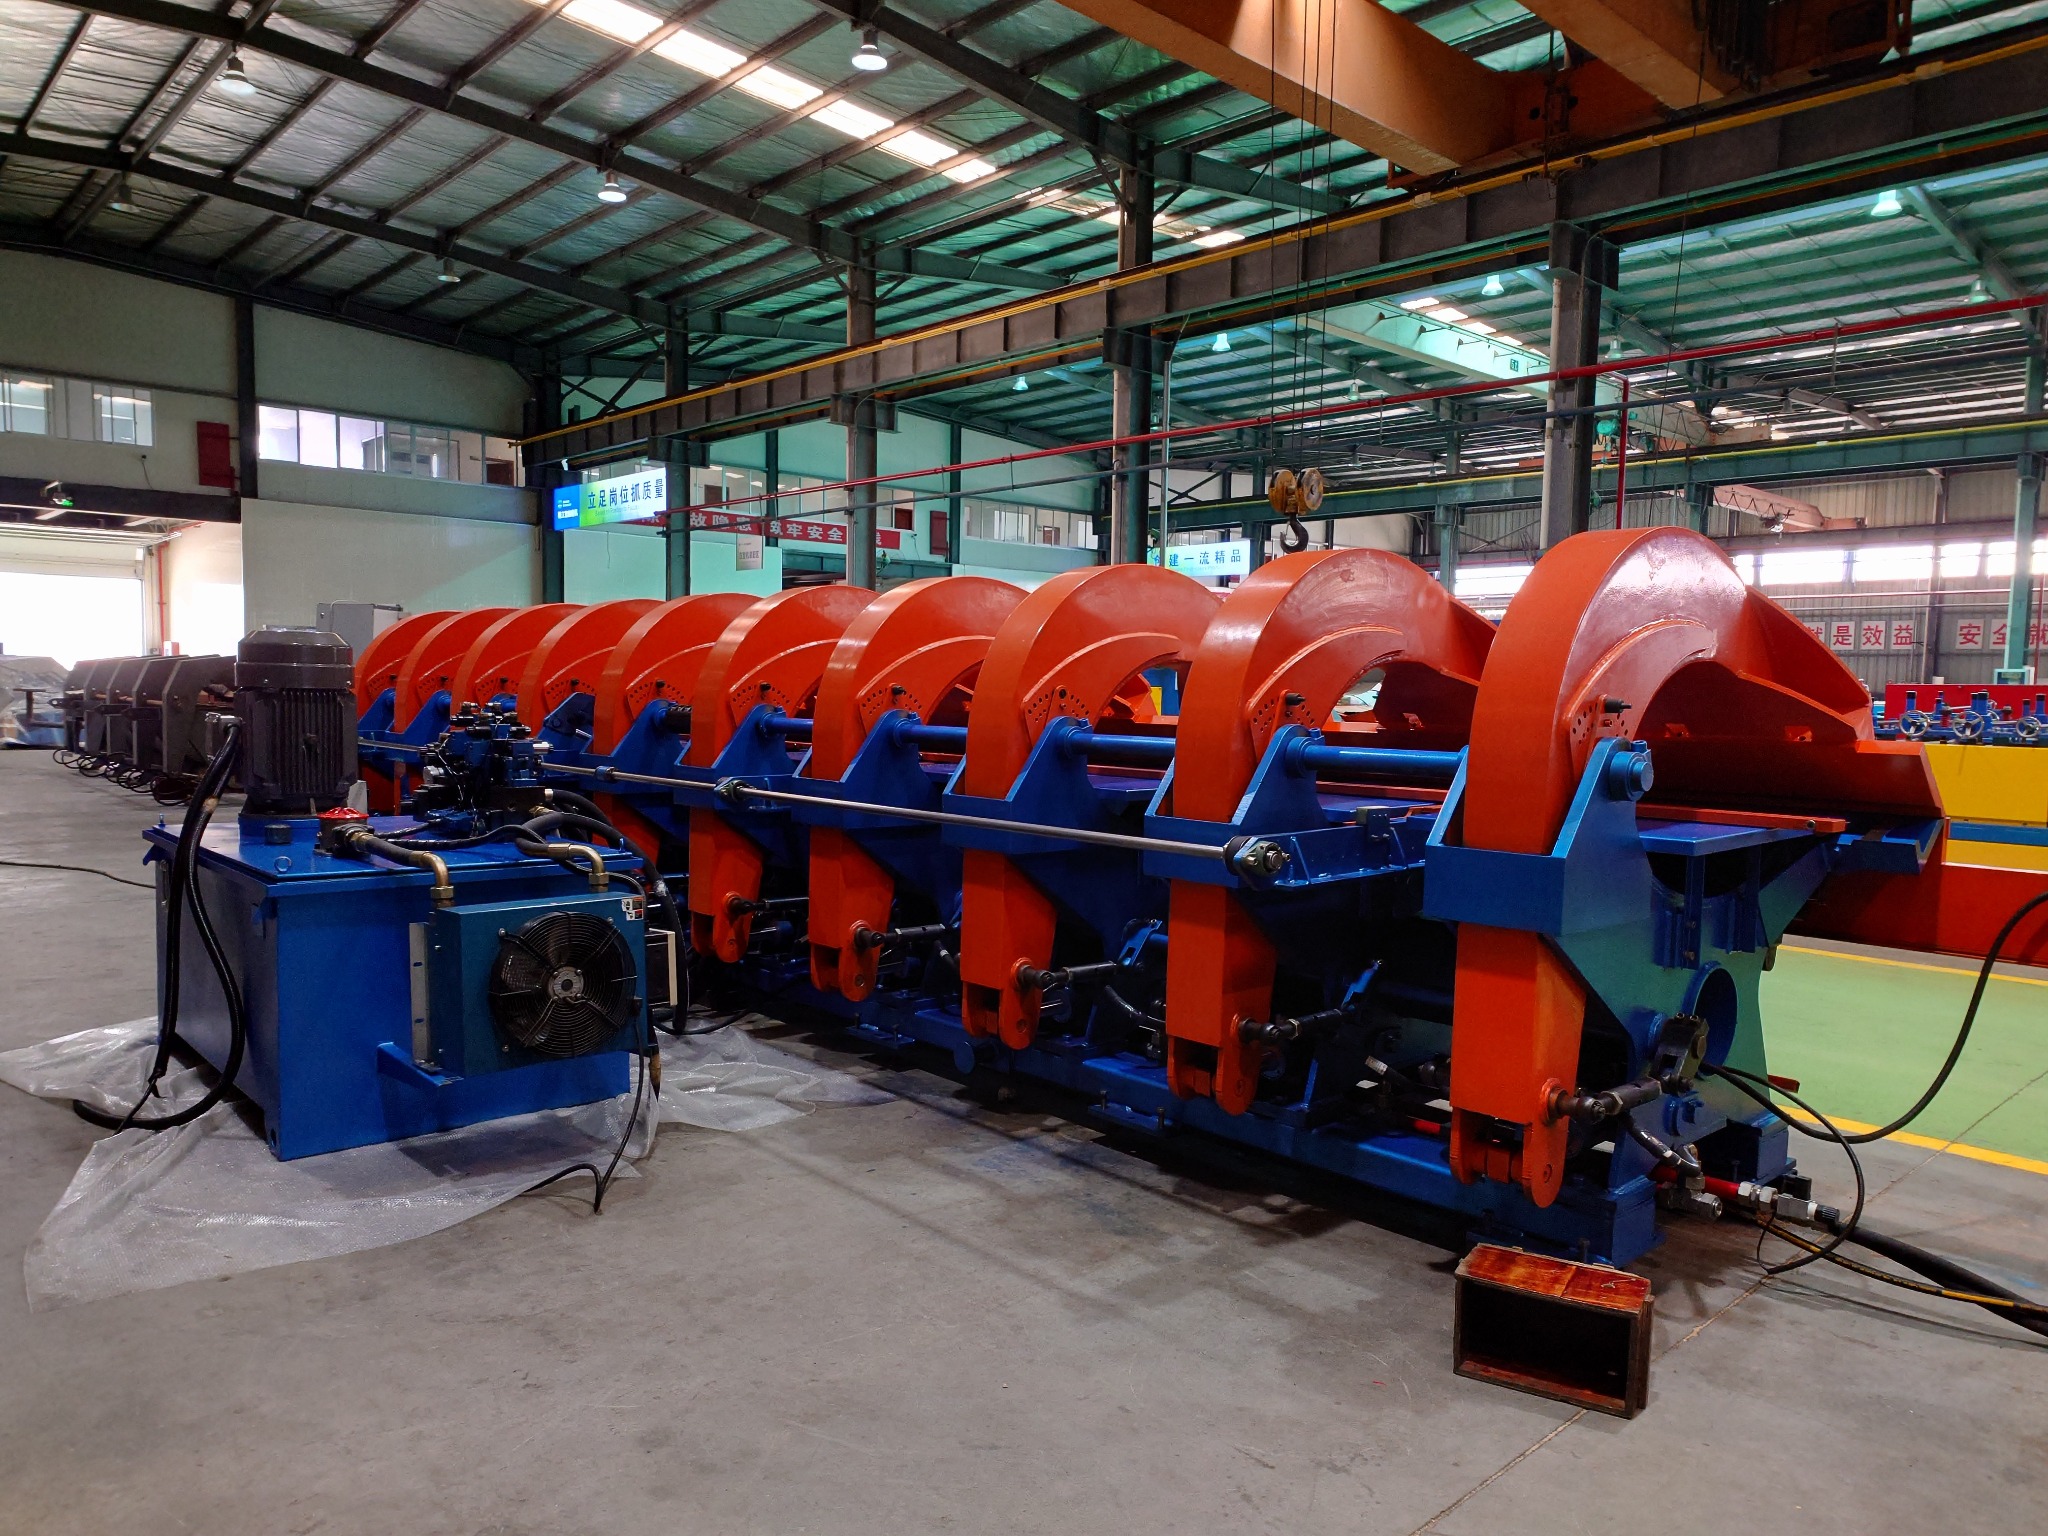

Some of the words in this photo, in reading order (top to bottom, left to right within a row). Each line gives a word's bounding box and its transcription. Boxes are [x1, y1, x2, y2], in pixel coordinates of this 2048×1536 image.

[587, 479, 664, 509] 立足岗位抓质量
